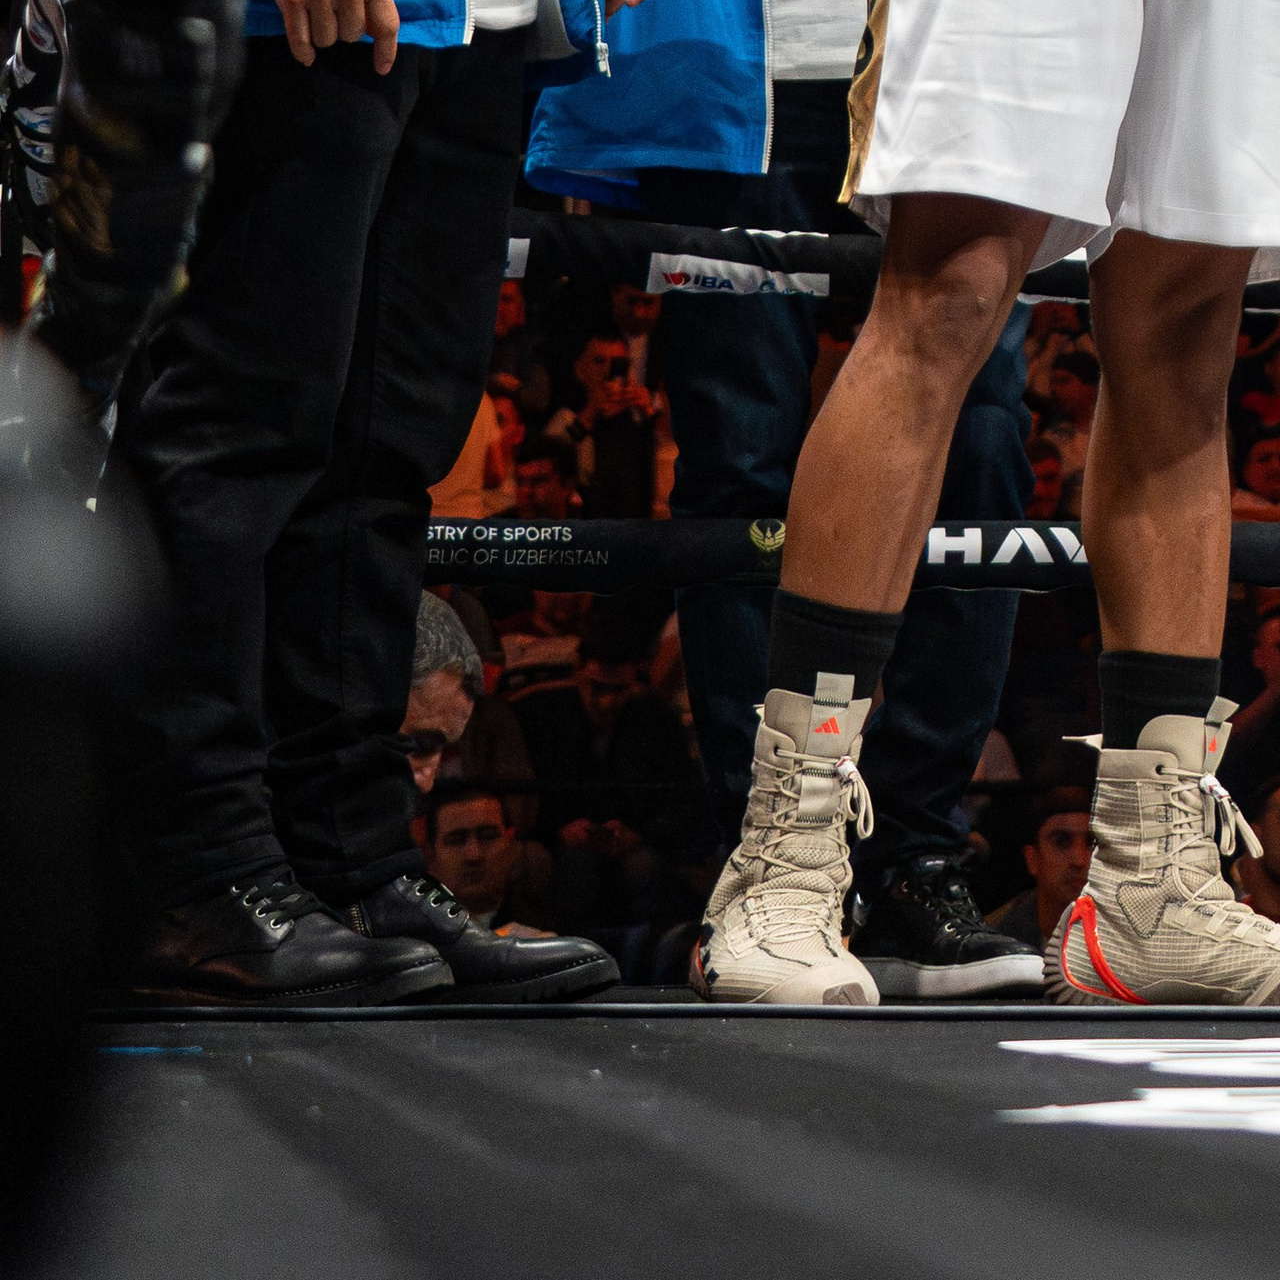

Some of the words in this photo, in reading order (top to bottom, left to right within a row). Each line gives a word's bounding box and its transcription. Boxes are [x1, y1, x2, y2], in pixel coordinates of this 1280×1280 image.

[694, 274, 735, 289] IBA
[473, 526, 498, 539] OF
[503, 526, 573, 541] SPORTS
[473, 549, 499, 564] OF
[504, 549, 608, 565] UZBEKISTAN
